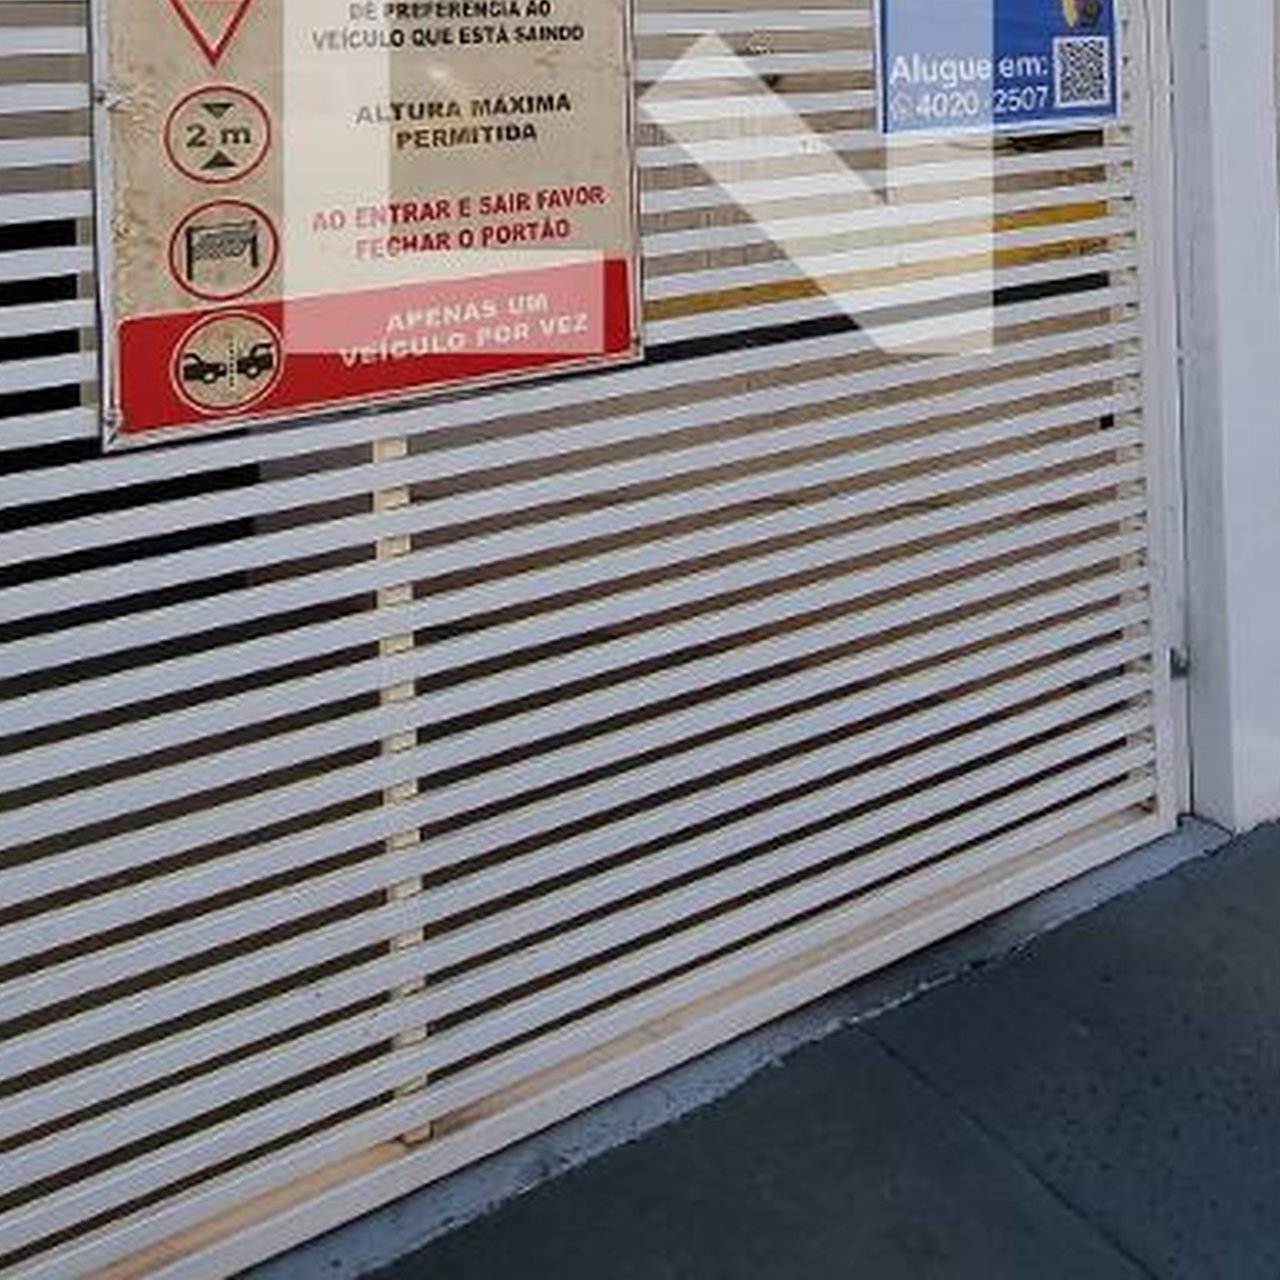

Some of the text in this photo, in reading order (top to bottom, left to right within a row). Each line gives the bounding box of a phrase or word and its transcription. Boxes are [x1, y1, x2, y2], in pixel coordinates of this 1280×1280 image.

[312, 27, 405, 50] VEÍCULO
[411, 27, 455, 48] QUE
[515, 25, 585, 42] SAINDO
[889, 53, 1049, 89] Alugue em:
[356, 100, 462, 125] ALTURA
[186, 122, 252, 149] 2 m
[396, 123, 538, 150] PERMITIDA
[312, 185, 606, 232] AO ENTRAR E SAIR FAVOR
[355, 231, 452, 260] FECHAR
[458, 228, 474, 249] O
[386, 292, 549, 334] APENAS UM
[338, 312, 589, 368] VEÍCULO POR VEZ
